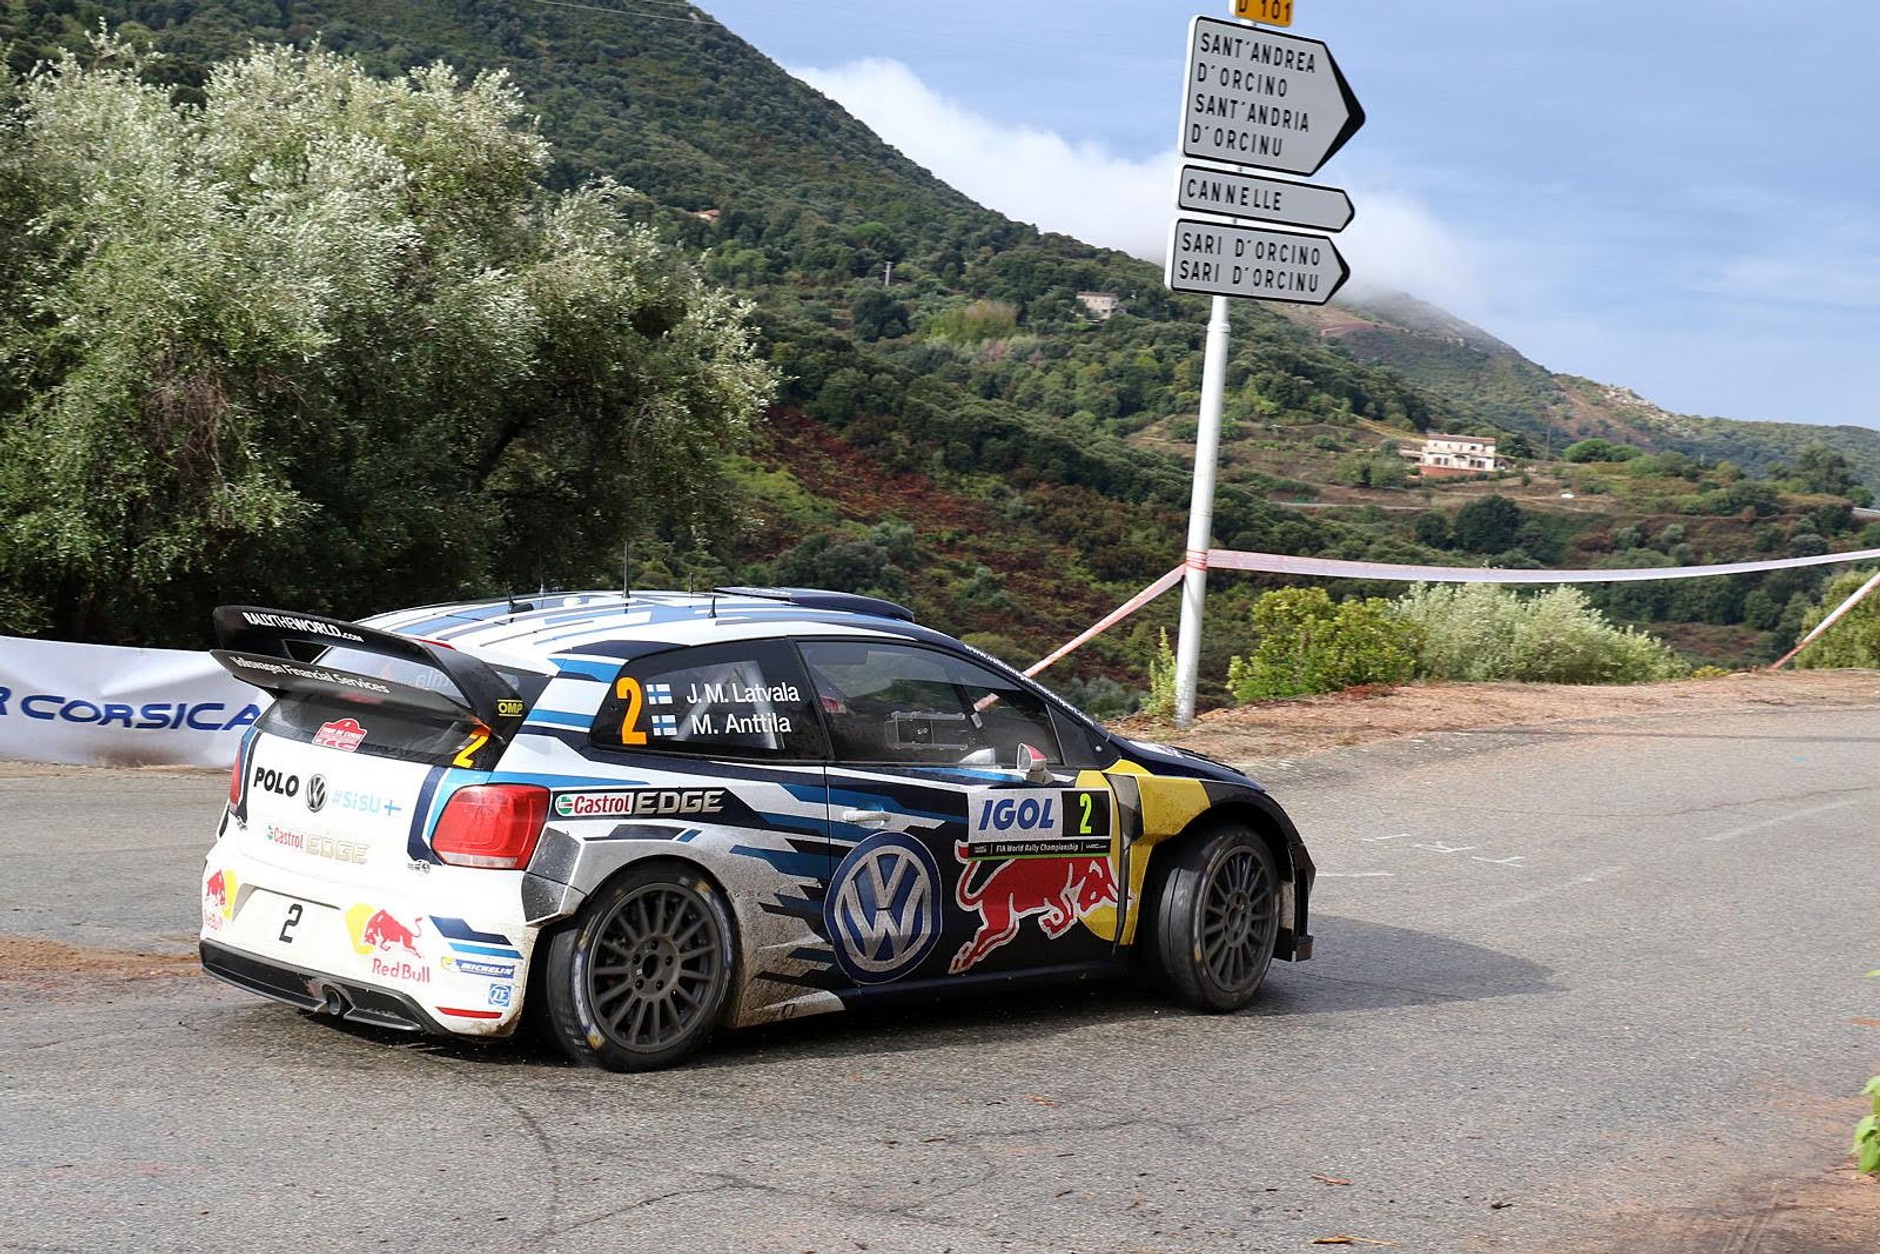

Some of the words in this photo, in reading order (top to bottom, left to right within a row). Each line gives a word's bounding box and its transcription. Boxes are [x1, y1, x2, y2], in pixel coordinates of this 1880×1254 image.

[1260, 0, 1291, 22] 101
[1200, 32, 1315, 74] SANT'ANDREA
[1197, 62, 1287, 98] D'ORCINO
[1194, 93, 1309, 133] SANT'ANDRIA
[1191, 123, 1282, 157] D'ORCINU
[1187, 178, 1282, 211] CANNELLE
[1181, 232, 1222, 256] SARI
[1235, 238, 1320, 267] D'ORCINO
[1179, 260, 1220, 283] SARI
[1232, 265, 1318, 293] D'ORCINU
[282, 664, 333, 683] Financial
[334, 673, 390, 694] Services
[686, 685, 702, 705] J.
[704, 686, 729, 704] M.
[732, 681, 800, 704] Latvala
[21, 694, 261, 731] CORSICA
[498, 702, 523, 715] OMP
[616, 676, 648, 746] 2
[692, 715, 719, 736] M.
[725, 713, 792, 735] Anttila
[453, 726, 491, 769] 2
[253, 767, 299, 797] POLO
[574, 795, 630, 814] Castrol
[634, 790, 726, 815] EDGE
[978, 798, 1054, 831] IGOL
[1079, 793, 1092, 834] 2
[274, 828, 303, 848] Castrol
[306, 834, 370, 864] EDGE
[996, 845, 1006, 853] FIA
[1007, 844, 1024, 853] World
[1025, 844, 1039, 854] Rally
[1040, 843, 1078, 853] Championship
[279, 904, 303, 943] 2
[372, 957, 398, 978] Red
[401, 963, 430, 983] Bull
[460, 962, 514, 976] MICHELIN
